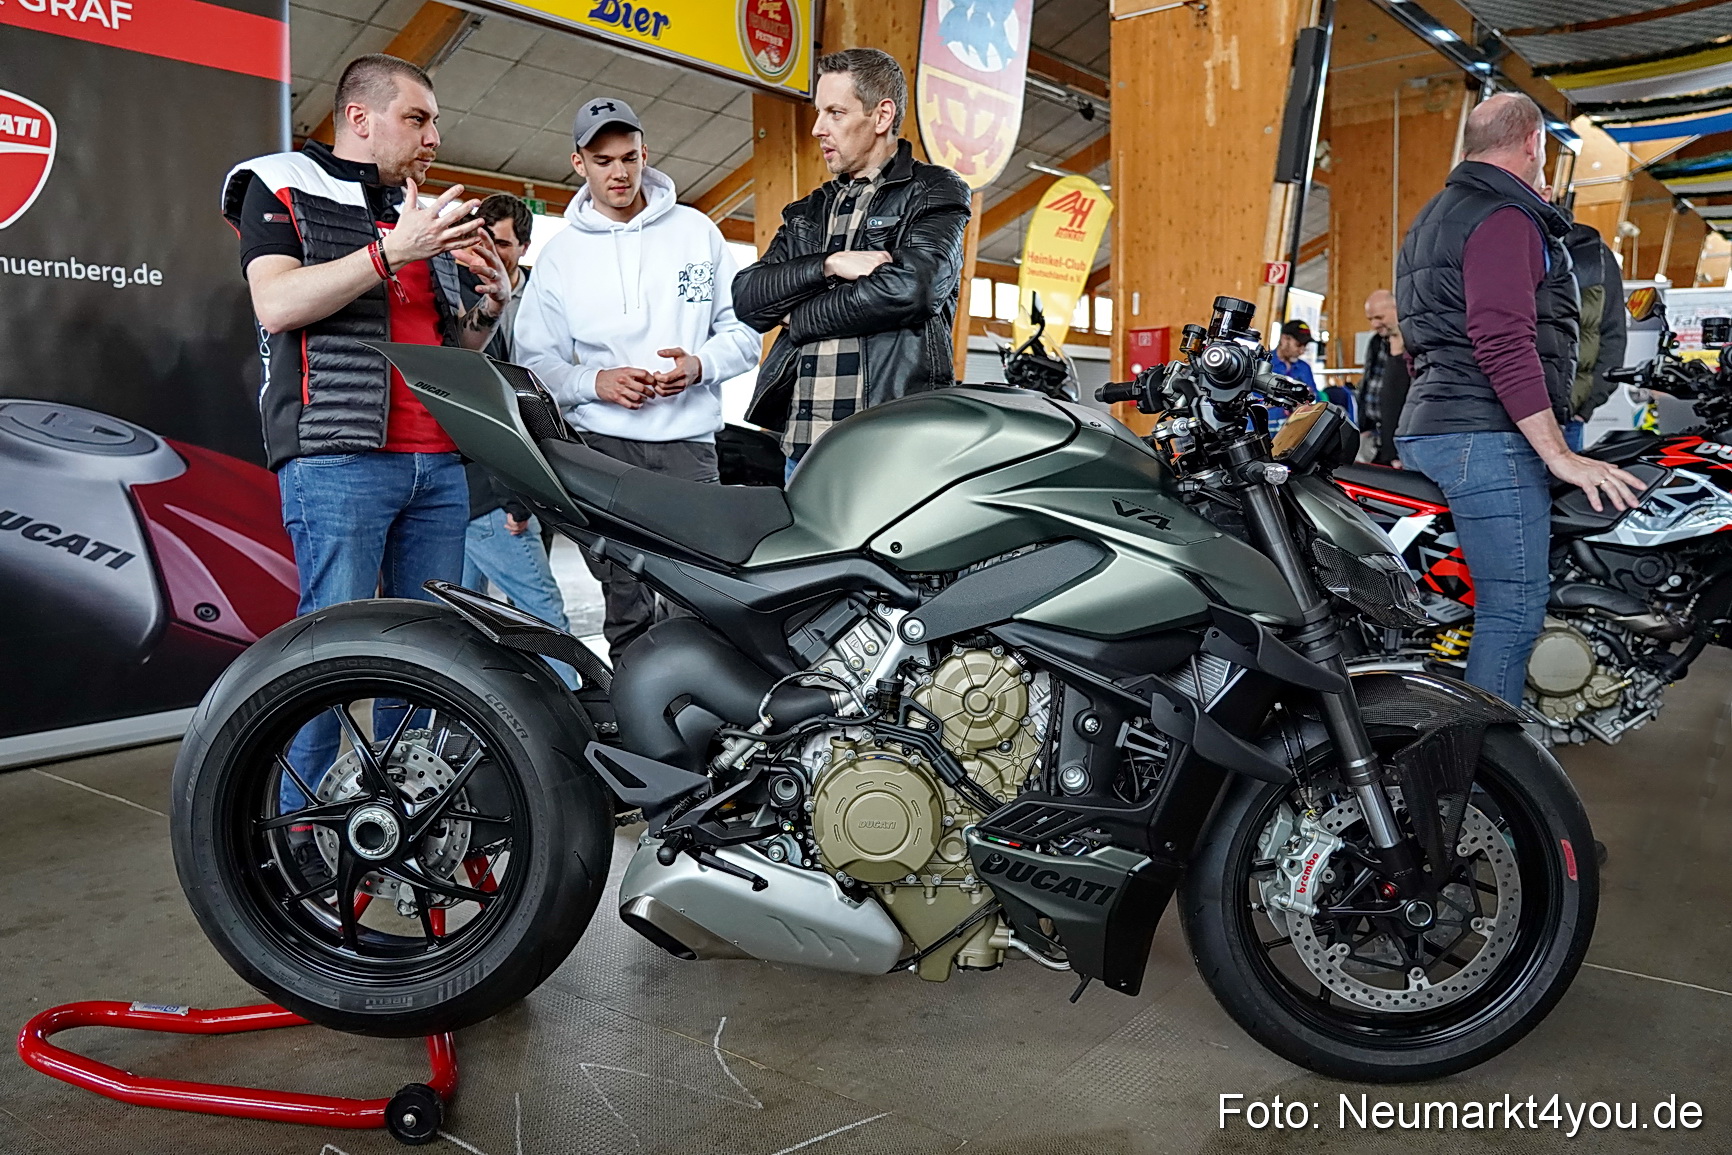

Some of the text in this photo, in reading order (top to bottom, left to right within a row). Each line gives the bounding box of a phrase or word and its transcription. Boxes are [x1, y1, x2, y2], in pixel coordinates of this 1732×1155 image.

[588, 0, 670, 38] Bier
[1027, 251, 1087, 272] Heinkel-Club
[414, 381, 451, 398] DUCATI
[1111, 499, 1172, 531] V4
[0, 510, 136, 570] UCATI
[485, 693, 529, 739] CORSA
[858, 820, 897, 830] DUCATI
[980, 852, 1117, 906] DUCATI
[1296, 852, 1319, 894] brembo
